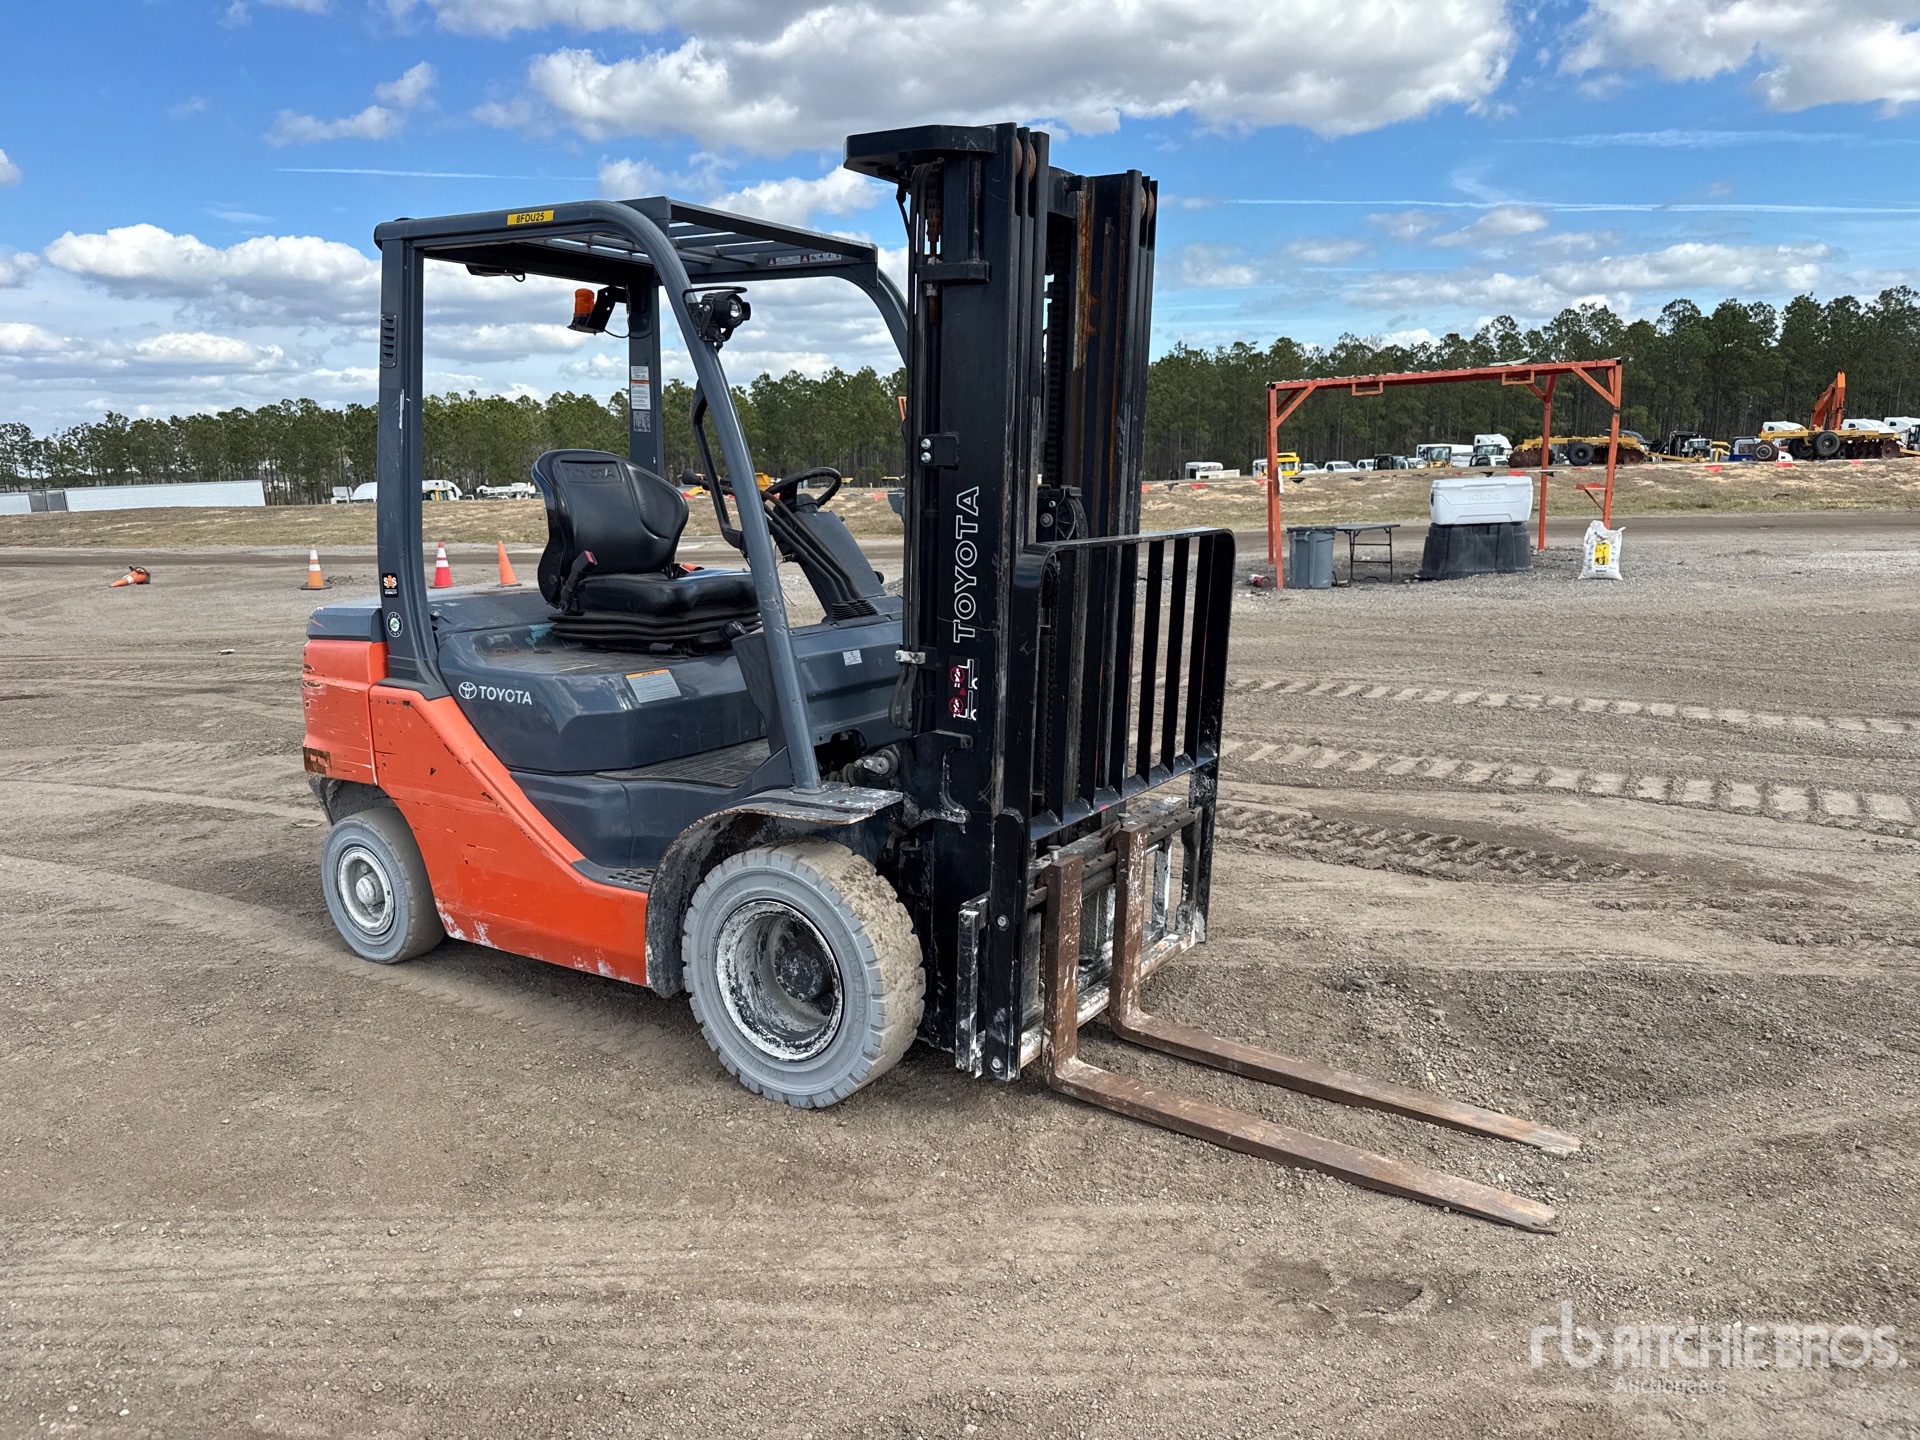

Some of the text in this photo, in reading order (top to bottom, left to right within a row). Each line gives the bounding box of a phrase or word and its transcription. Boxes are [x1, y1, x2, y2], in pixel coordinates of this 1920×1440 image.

[516, 212, 545, 224] 8FDU25
[953, 486, 980, 643] TOYOTA
[479, 686, 533, 705] TOYOTA
